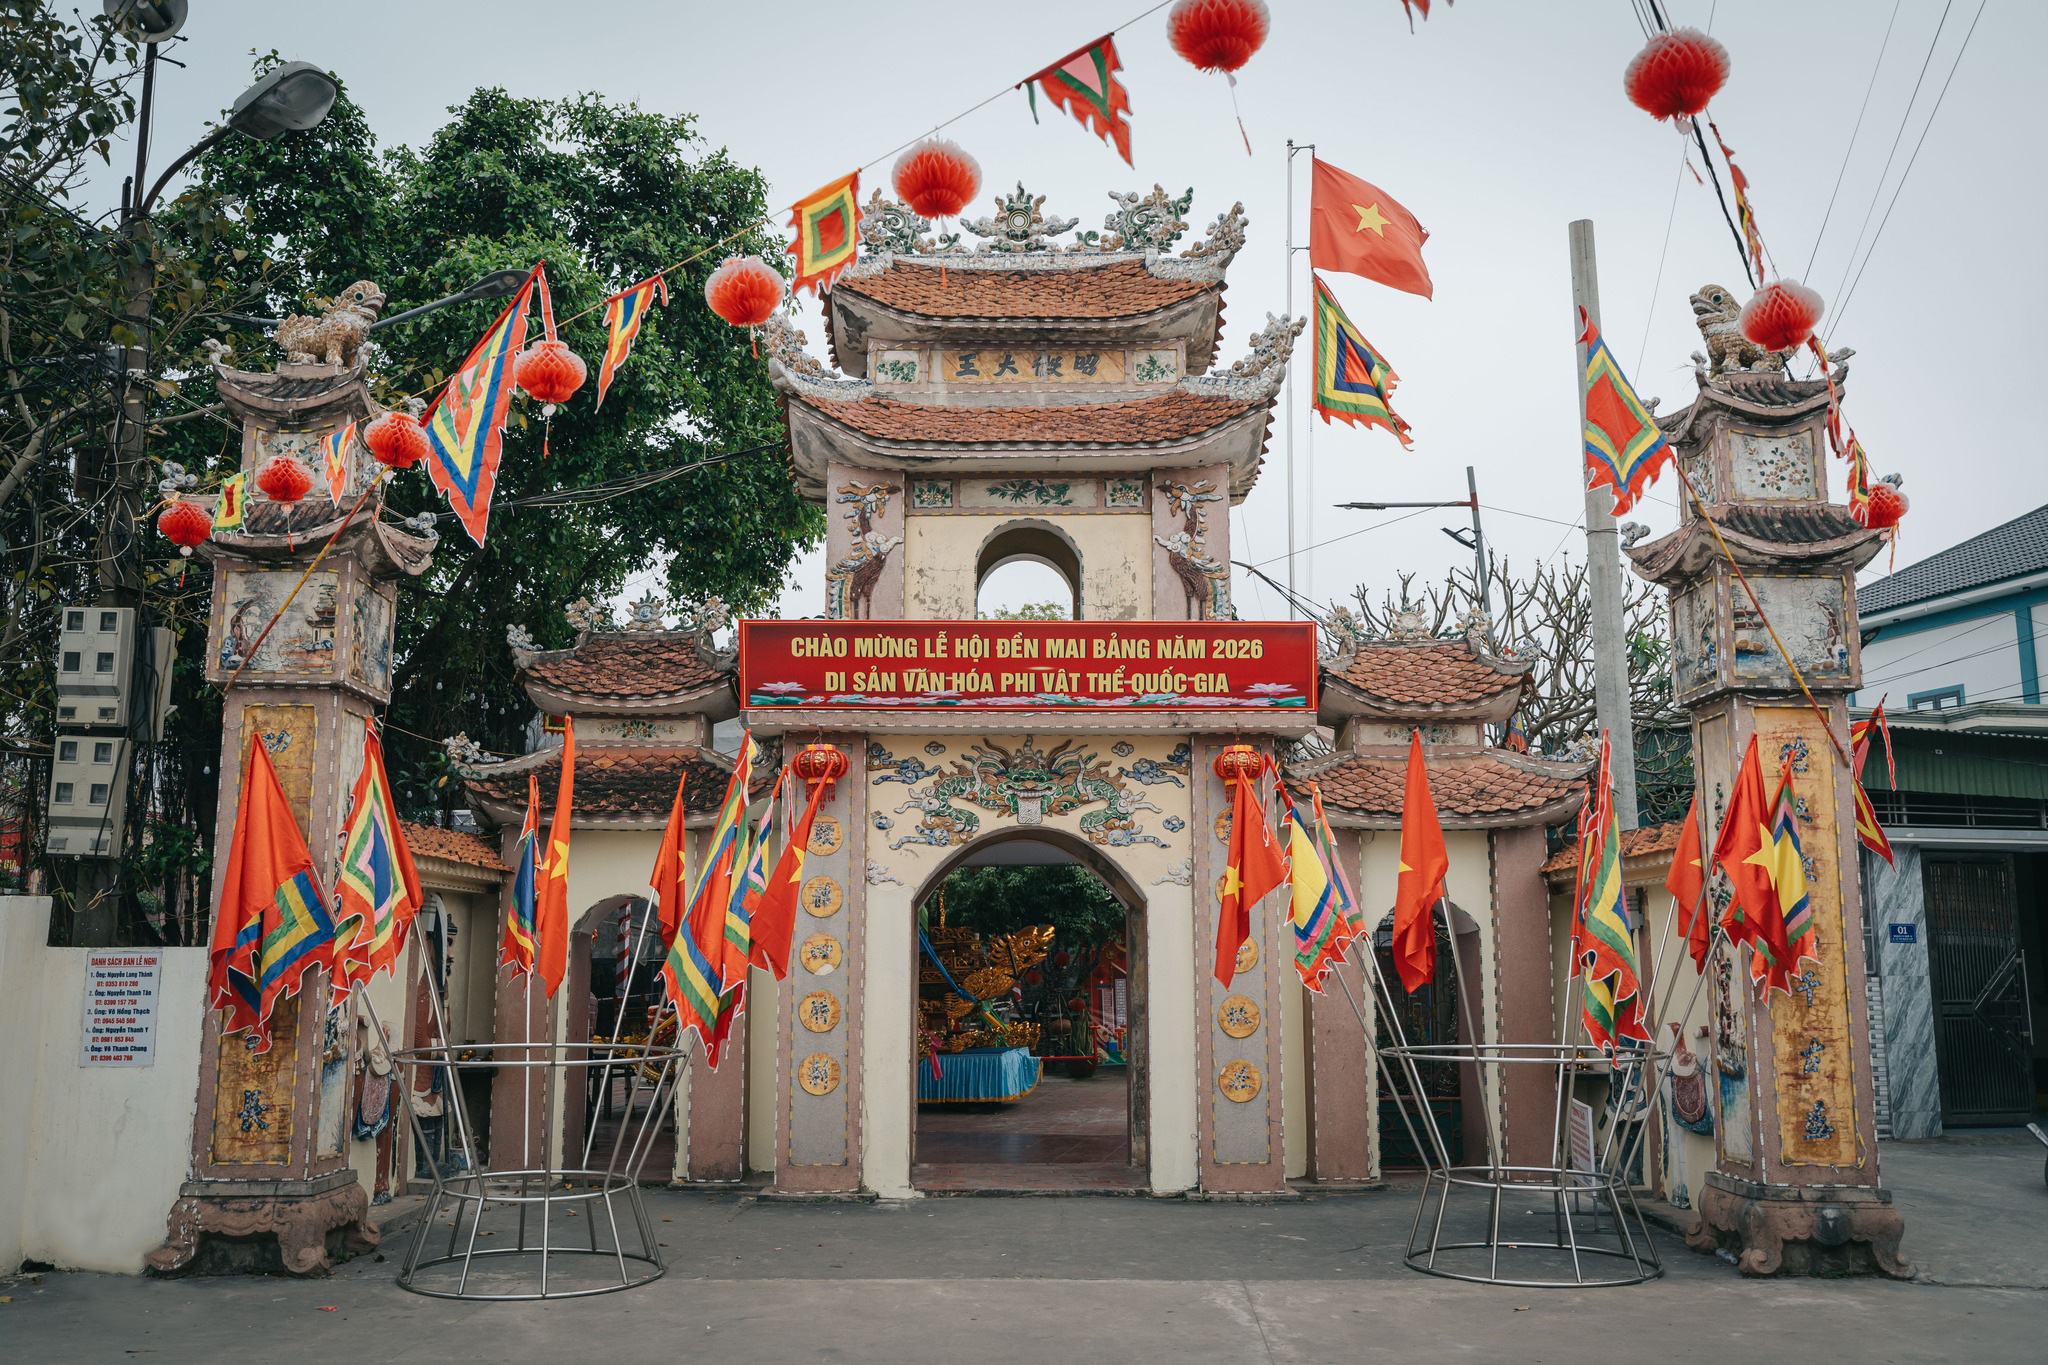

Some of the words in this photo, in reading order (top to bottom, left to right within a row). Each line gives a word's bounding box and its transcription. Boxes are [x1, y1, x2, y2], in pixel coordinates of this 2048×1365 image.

[791, 633, 848, 658] CHÀO
[854, 633, 919, 658] MỪNG
[925, 631, 948, 658] LỄ
[955, 634, 990, 662] HỘI
[996, 632, 1039, 658] ĐỀN
[1046, 638, 1087, 659] MAI
[1093, 632, 1151, 659] BẢNG
[1157, 635, 1206, 659] NĂM
[1212, 639, 1264, 659] 2026
[825, 671, 846, 692] DI
[853, 665, 897, 692] SẢN
[903, 668, 946, 692] VĂN
[952, 667, 995, 692] HÓA
[1001, 672, 1035, 692] PHI
[1042, 669, 1081, 696] VẬT
[1087, 665, 1125, 692] THỂ
[1132, 666, 1188, 695] QUỐC
[1194, 672, 1229, 692] GIA
[1897, 926, 1908, 934] 01
[107, 956, 122, 965] SÁCH
[123, 957, 134, 965] BAN
